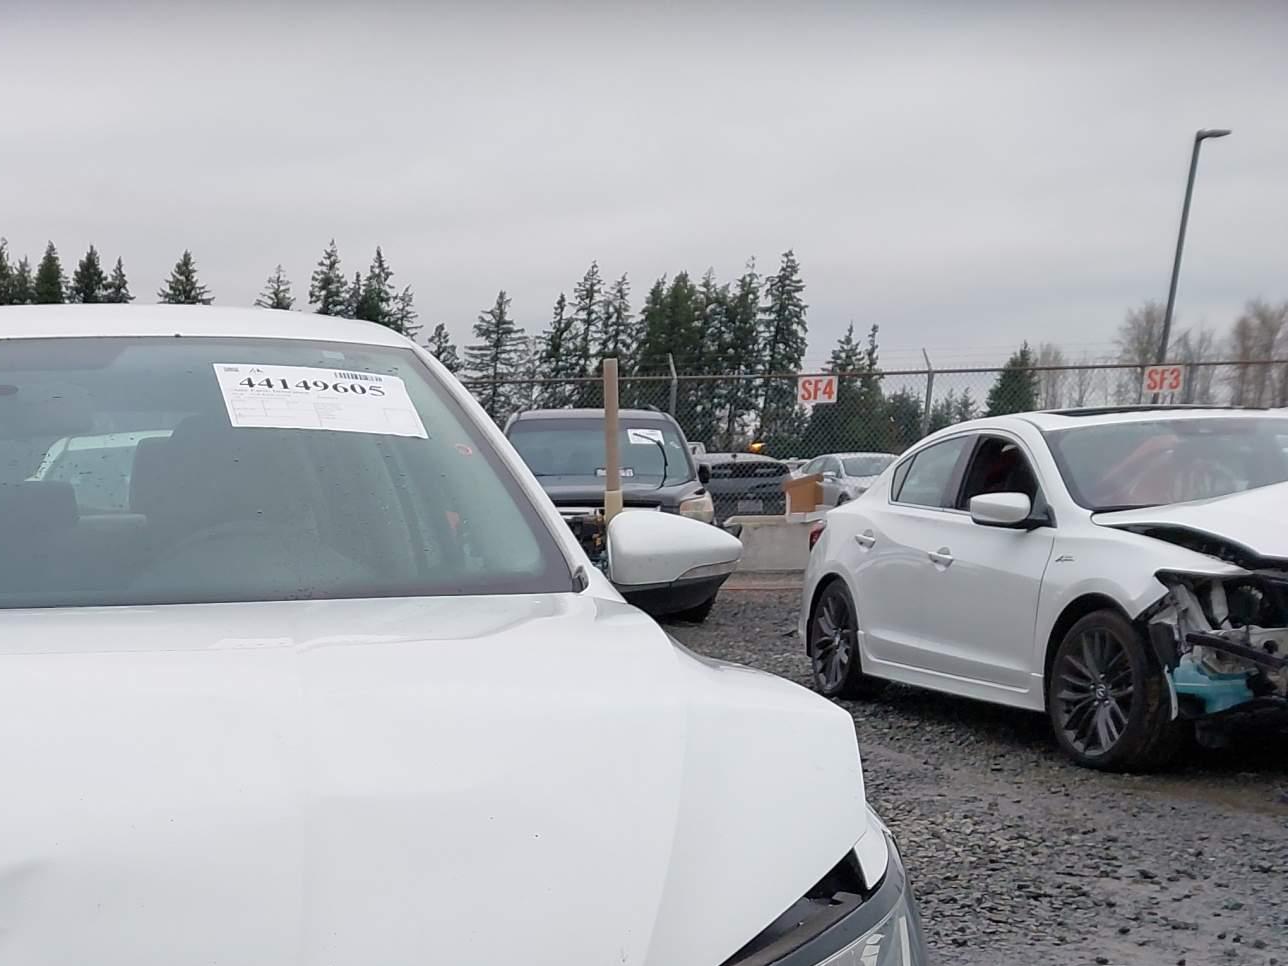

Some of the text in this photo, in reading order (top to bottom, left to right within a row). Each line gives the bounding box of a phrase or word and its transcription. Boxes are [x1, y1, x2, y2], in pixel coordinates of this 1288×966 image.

[239, 376, 386, 397] 44149605
[801, 378, 834, 401] SF4
[1147, 367, 1181, 390] SF3
